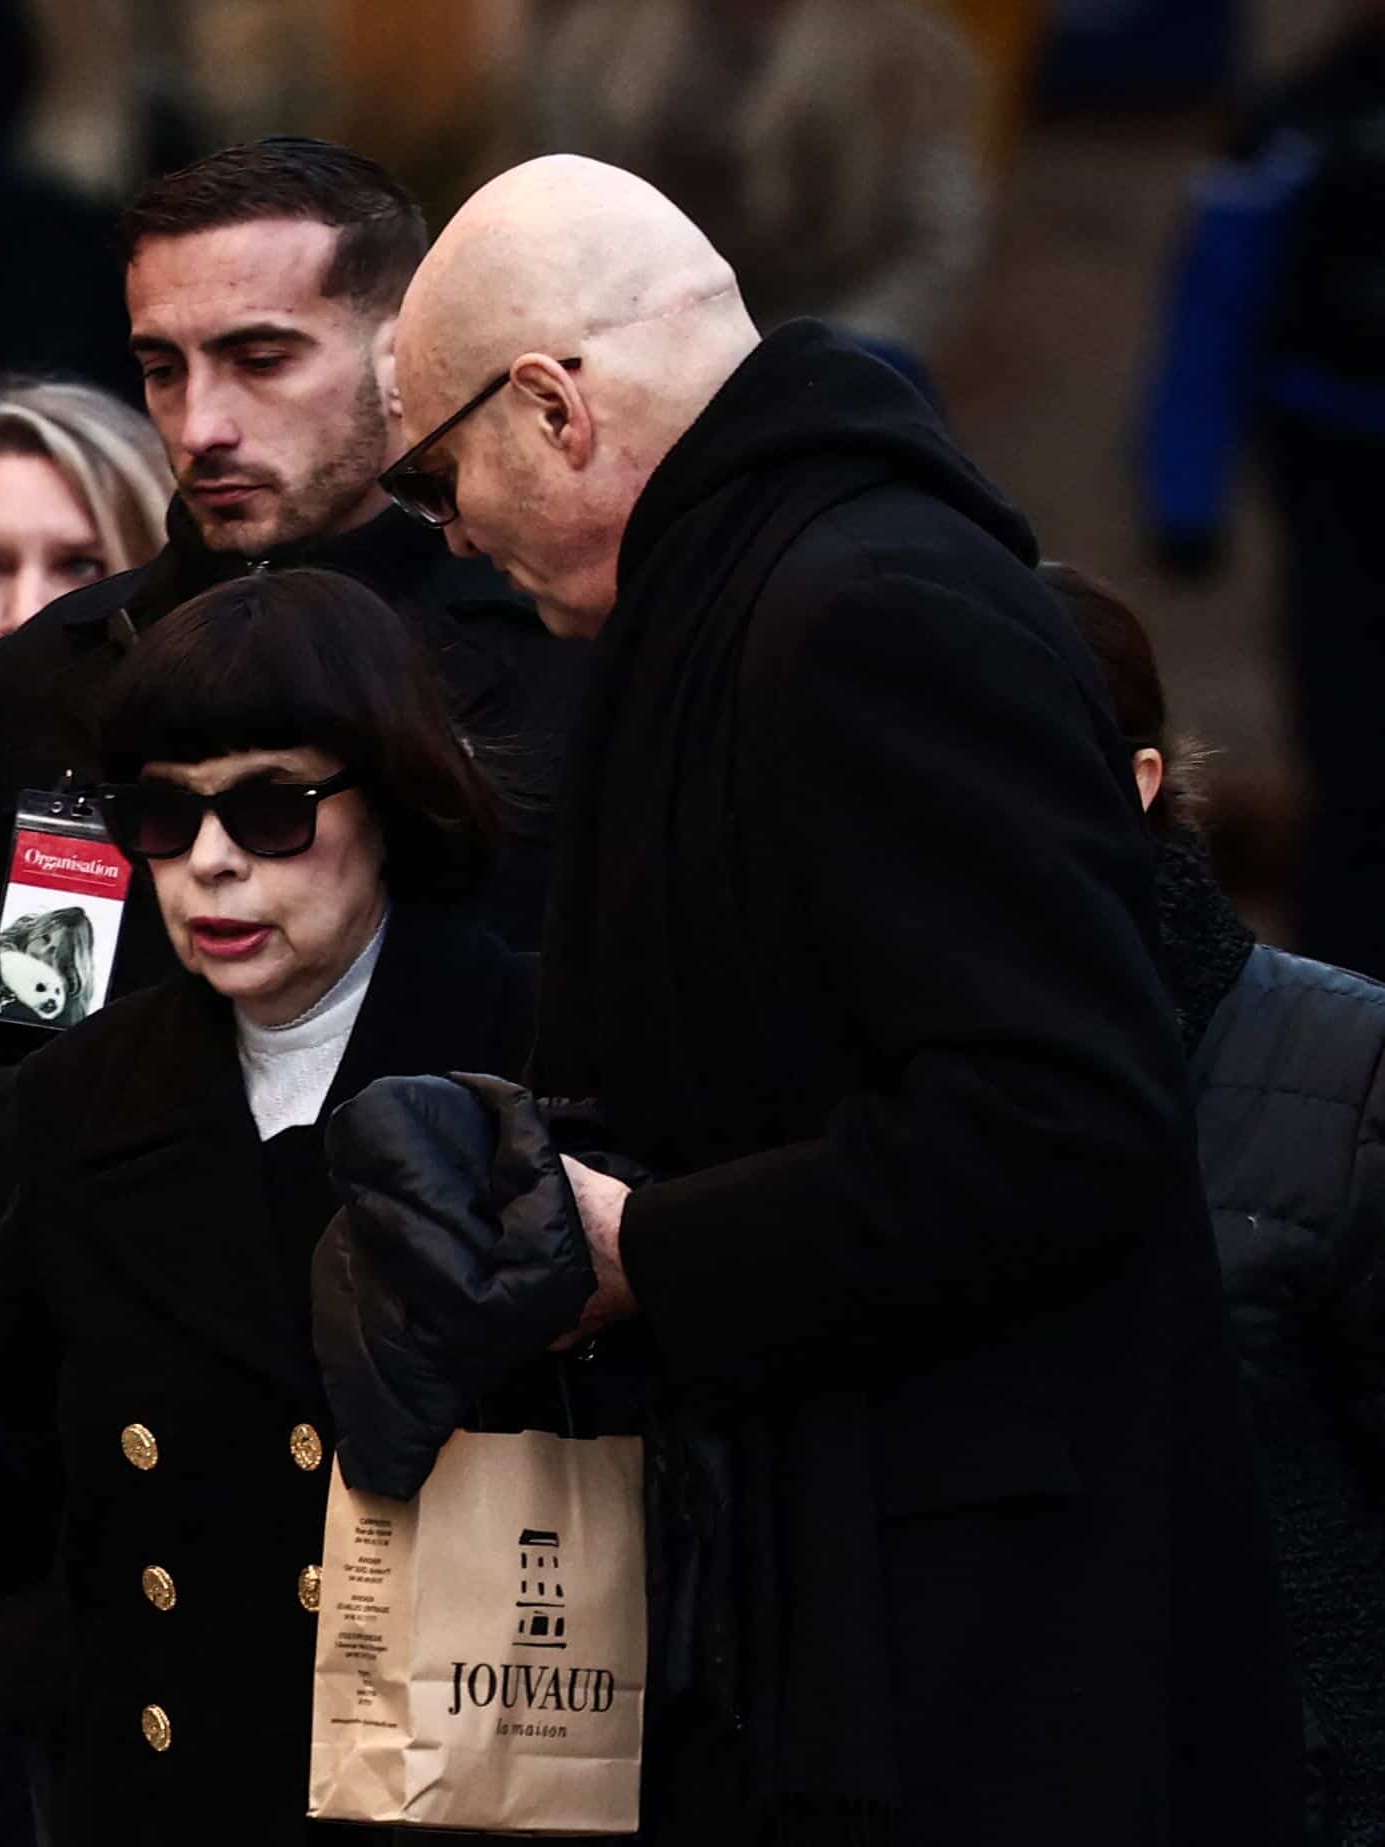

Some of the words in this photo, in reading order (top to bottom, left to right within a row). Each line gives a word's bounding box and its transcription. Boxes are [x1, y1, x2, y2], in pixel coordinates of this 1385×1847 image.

[24, 847, 119, 878] Organisation
[447, 1661, 615, 1715] JOUVAUD
[511, 1720, 568, 1739] maison
